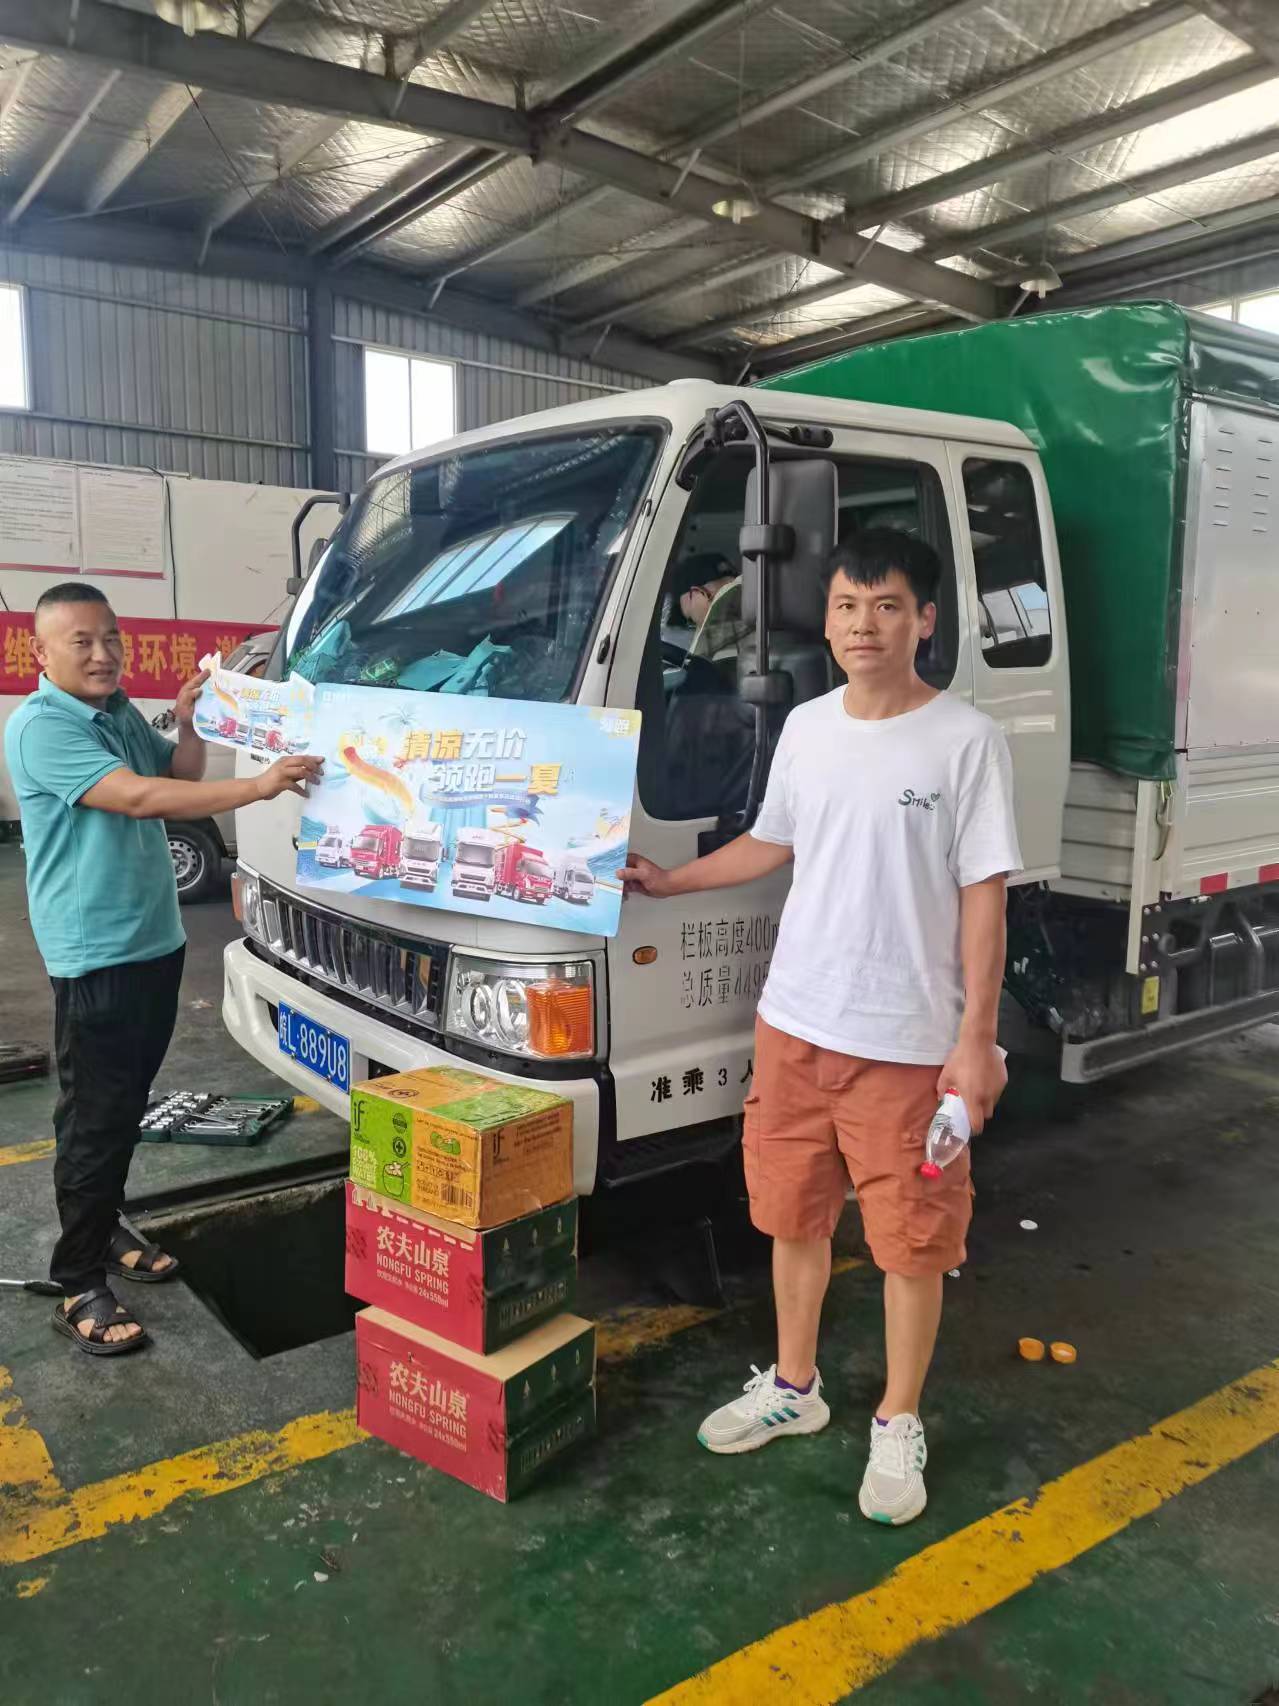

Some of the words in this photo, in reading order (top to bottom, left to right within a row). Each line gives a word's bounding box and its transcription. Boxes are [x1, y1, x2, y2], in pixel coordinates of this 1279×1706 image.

[404, 729, 528, 760] 清凉无价
[430, 764, 562, 795] 领跑一夏
[353, 1100, 365, 1132] if
[376, 1225, 449, 1276] 农夫山泉
[376, 1251, 412, 1278] NONGFU
[415, 1269, 449, 1294] SPRING
[389, 1361, 468, 1422] 农夫山泉
[389, 1389, 426, 1418] NONGFU
[429, 1409, 467, 1438] SPRING
